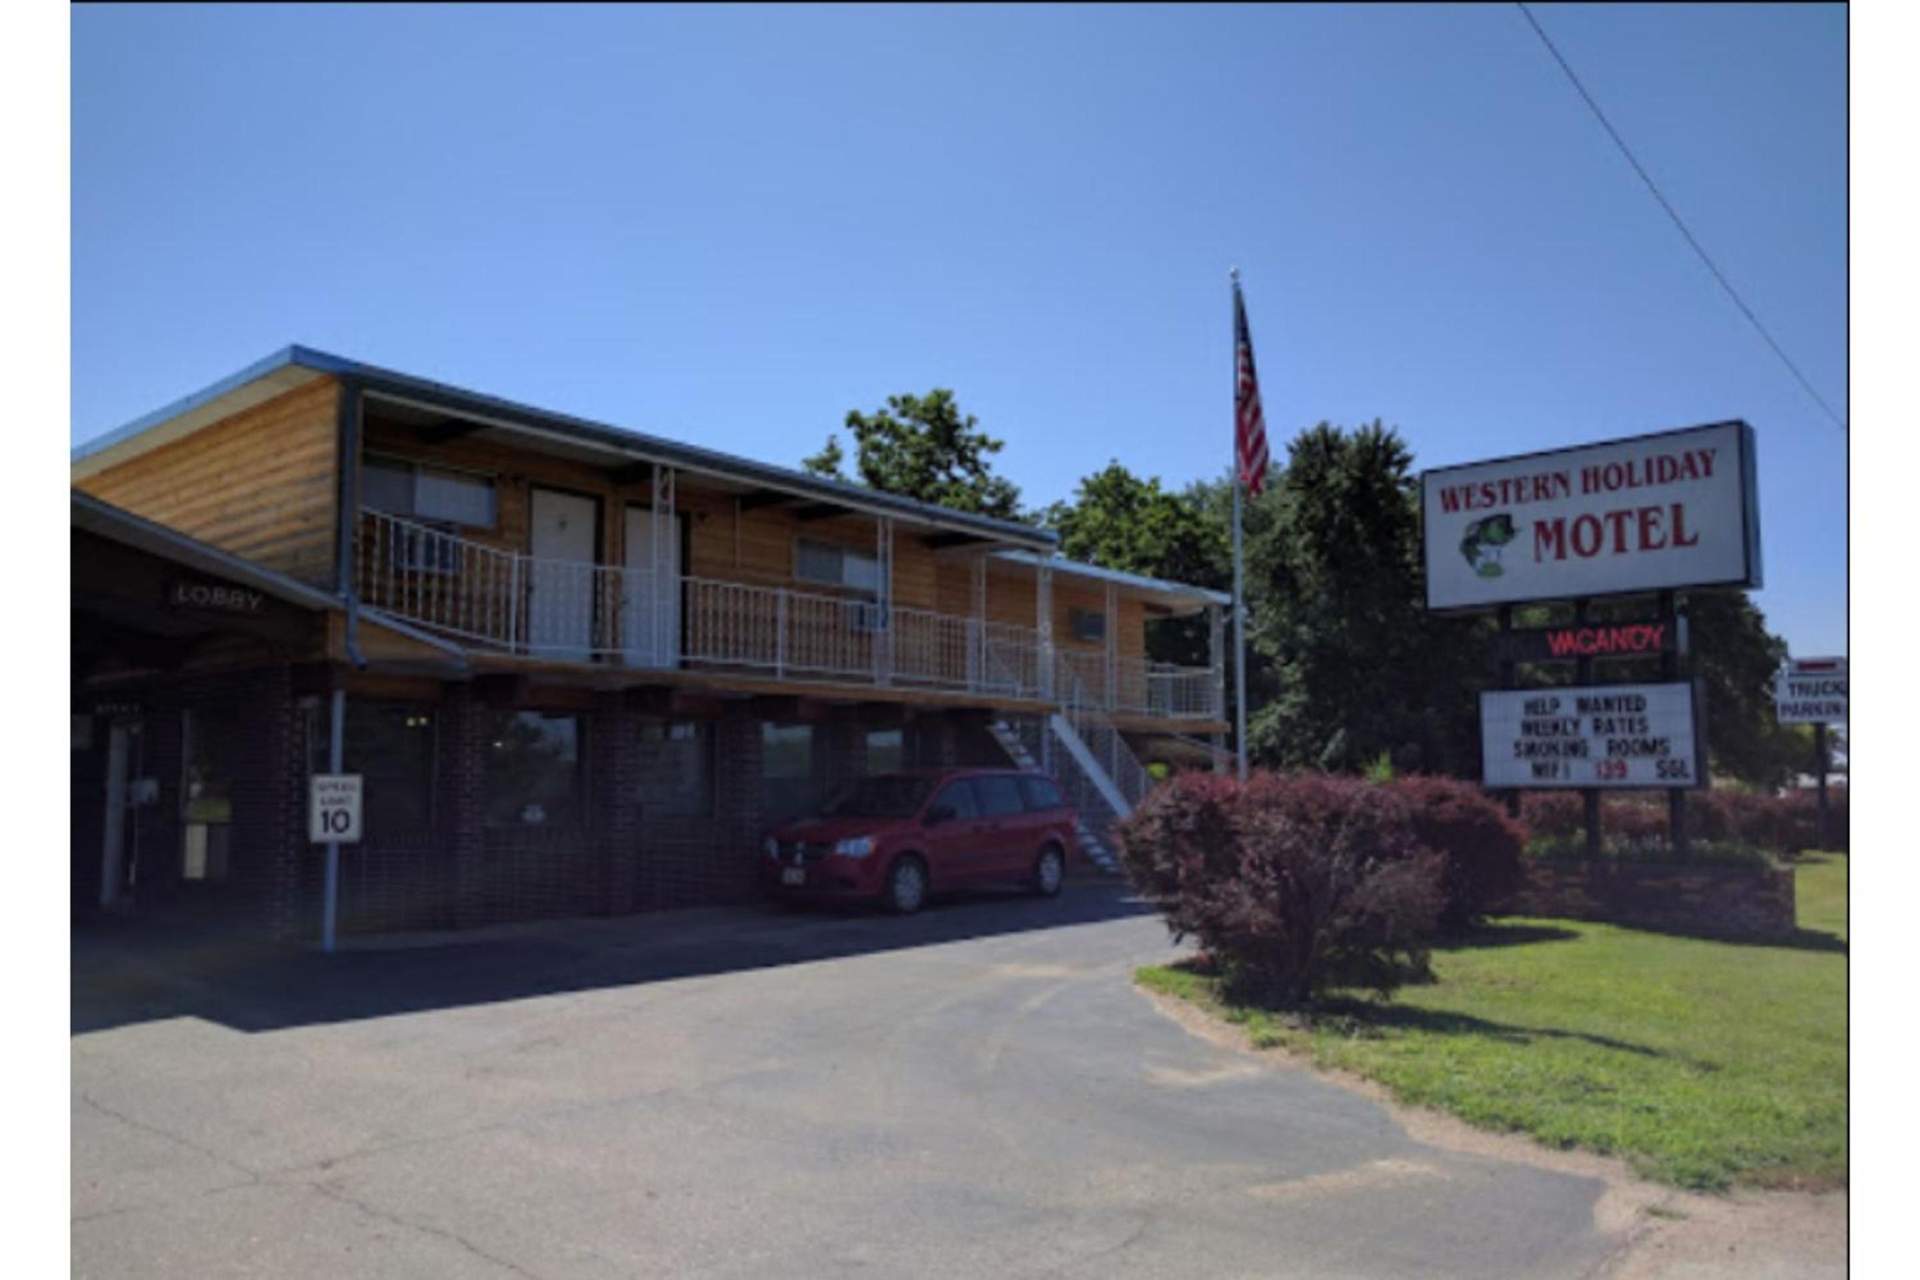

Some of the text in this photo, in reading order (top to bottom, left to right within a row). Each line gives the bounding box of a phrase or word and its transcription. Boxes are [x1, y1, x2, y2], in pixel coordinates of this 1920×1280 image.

[1439, 448, 1718, 514] WESTERN HOLIDAY
[1533, 502, 1699, 564] MOTEL
[176, 584, 264, 611] LOBBY
[1546, 623, 1665, 656] VACANCY
[1523, 694, 1648, 716] HELP WANTED
[1521, 715, 1650, 736] WEEKLY RATES
[1513, 736, 1671, 758] SMOKING ROOMS
[322, 808, 350, 834] 10
